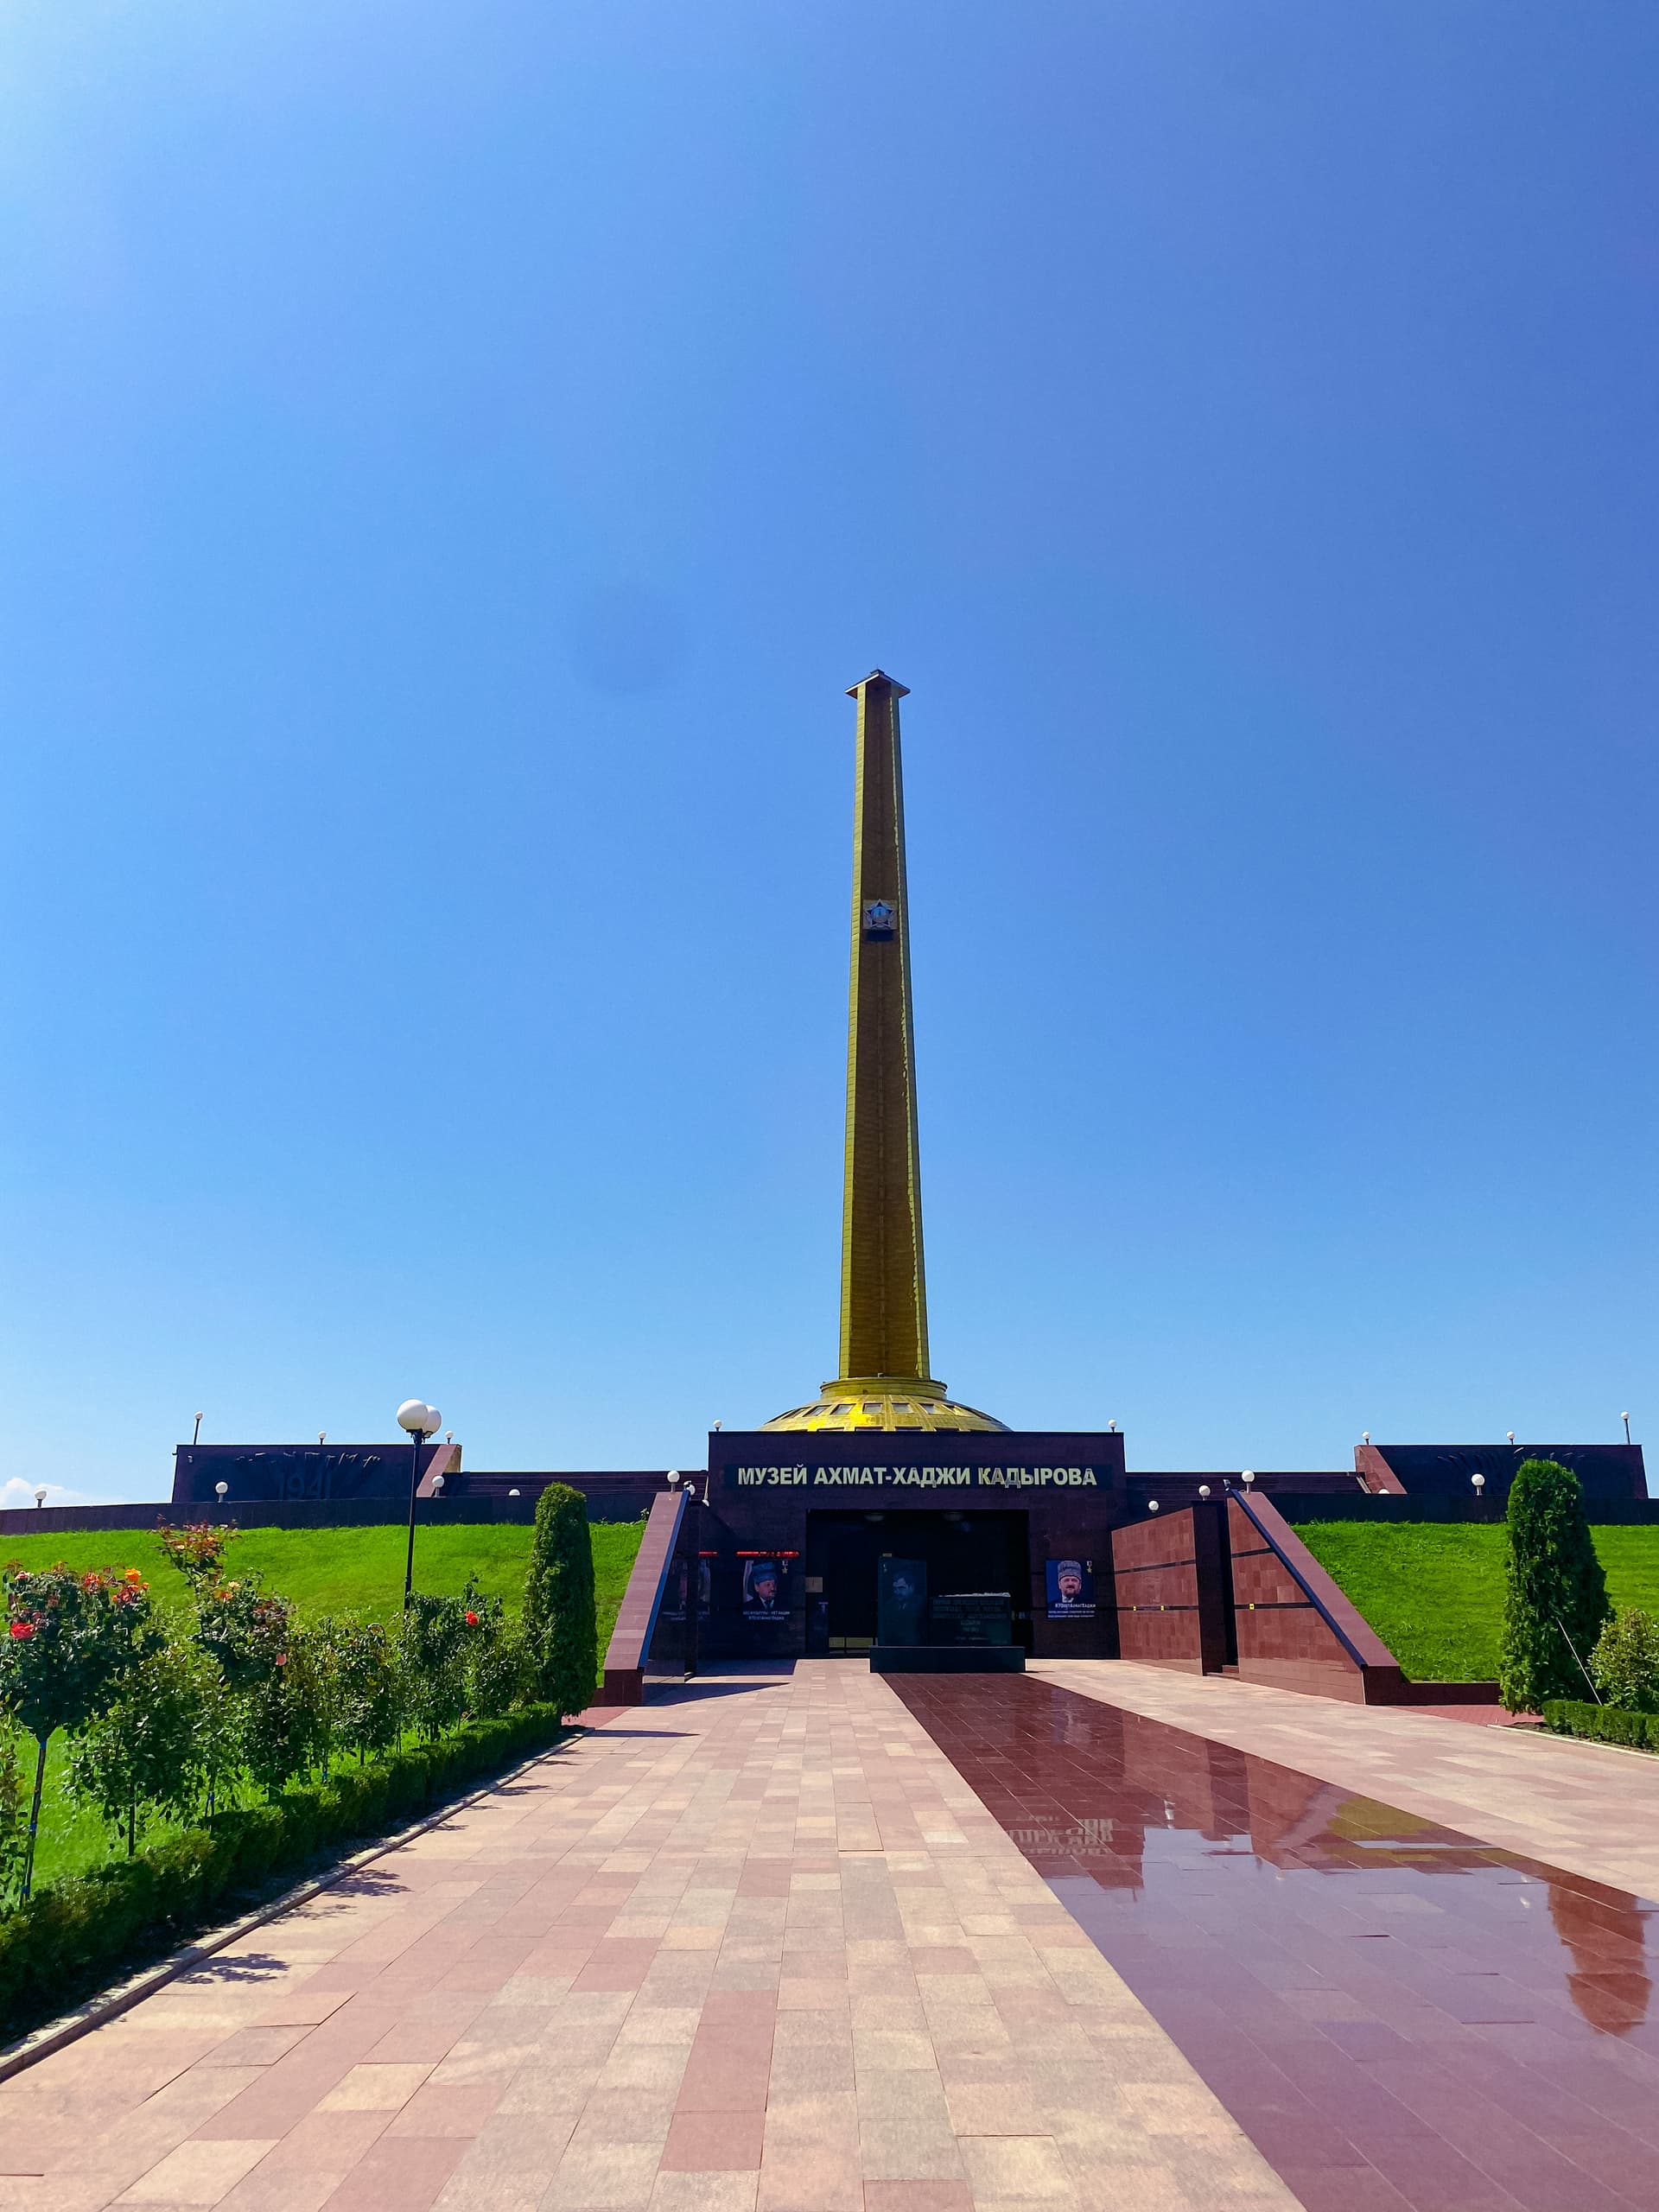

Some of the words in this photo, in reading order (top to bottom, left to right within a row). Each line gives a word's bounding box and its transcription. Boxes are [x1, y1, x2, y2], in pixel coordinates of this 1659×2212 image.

[738, 1464, 807, 1484] МУЗЕЙ
[813, 1467, 970, 1488] АХМАТ-ХАДЖИ
[978, 1467, 1097, 1489] КАДЫРОВА
